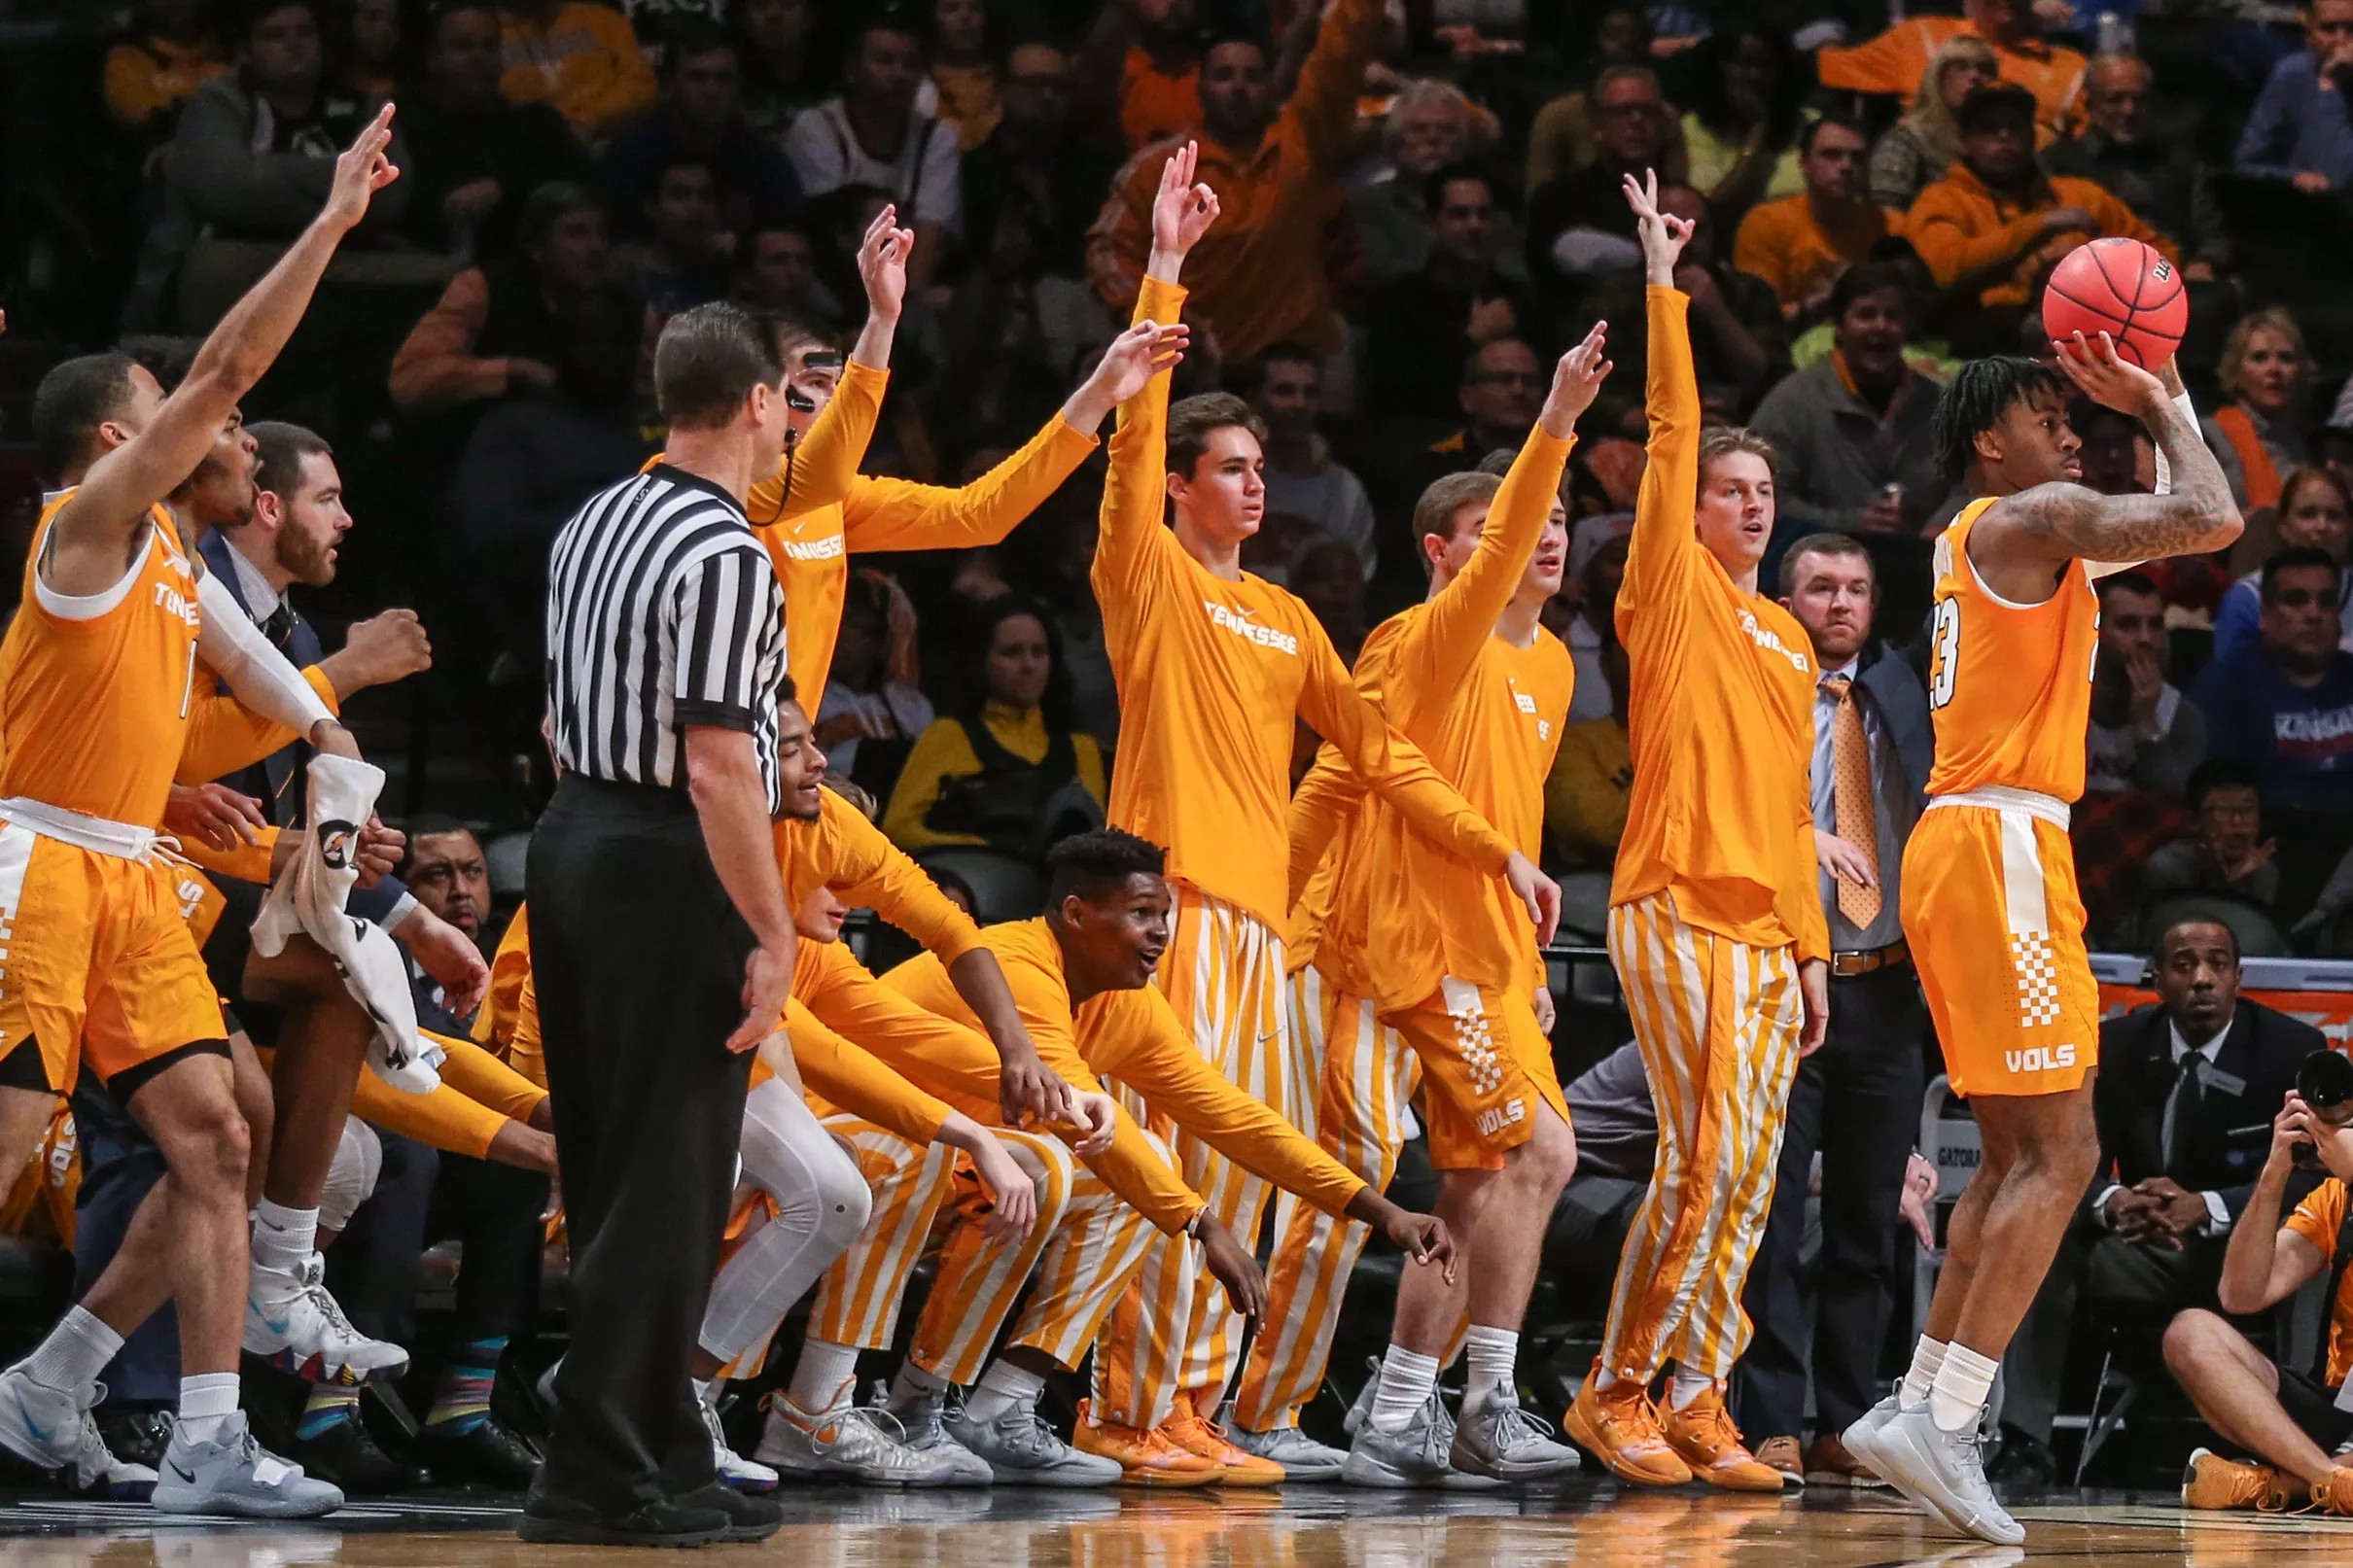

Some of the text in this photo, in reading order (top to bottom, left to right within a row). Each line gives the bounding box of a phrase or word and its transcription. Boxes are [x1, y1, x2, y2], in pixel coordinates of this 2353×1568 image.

[1204, 600, 1299, 656] TENNESSEE
[2005, 1043, 2076, 1073] VOLS
[1474, 1098, 1526, 1136] VOLS
